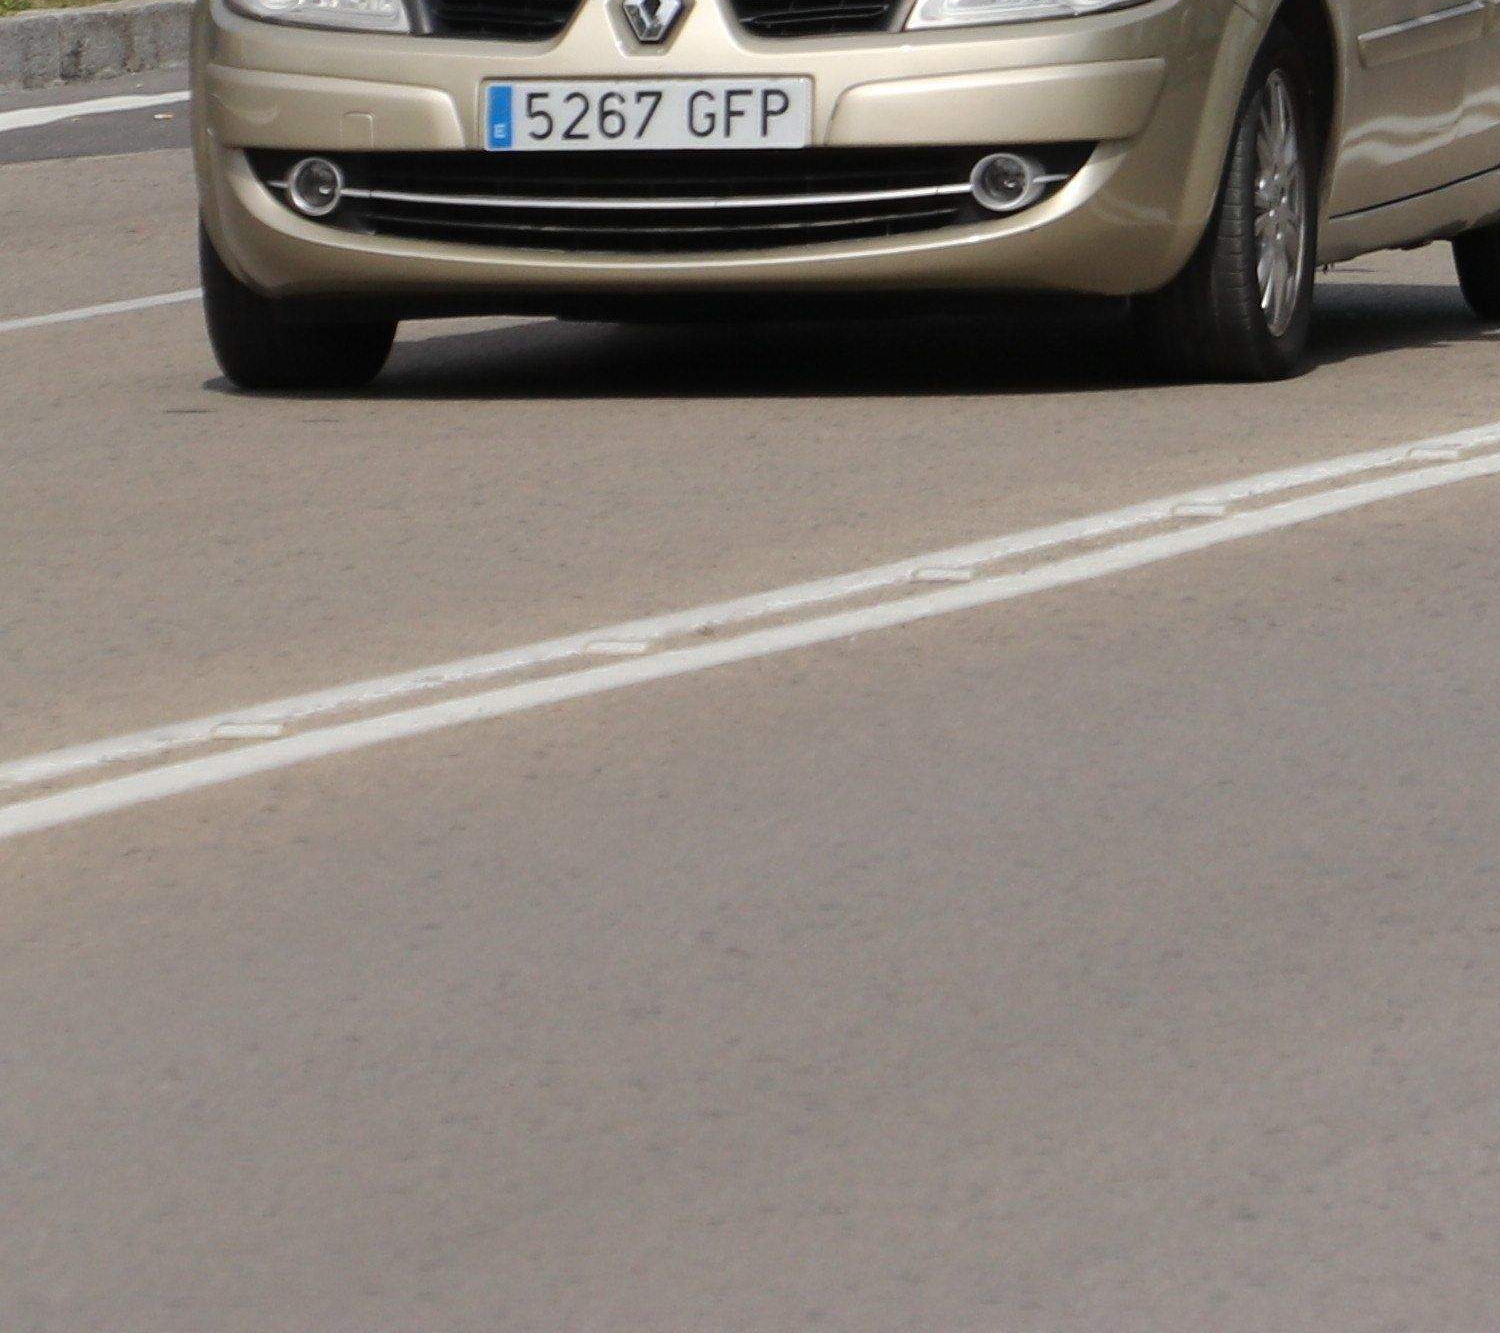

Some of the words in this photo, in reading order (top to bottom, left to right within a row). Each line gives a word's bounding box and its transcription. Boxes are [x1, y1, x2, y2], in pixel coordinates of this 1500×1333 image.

[493, 123, 507, 139] E
[526, 90, 664, 141] 5267
[686, 88, 790, 139] GFP
